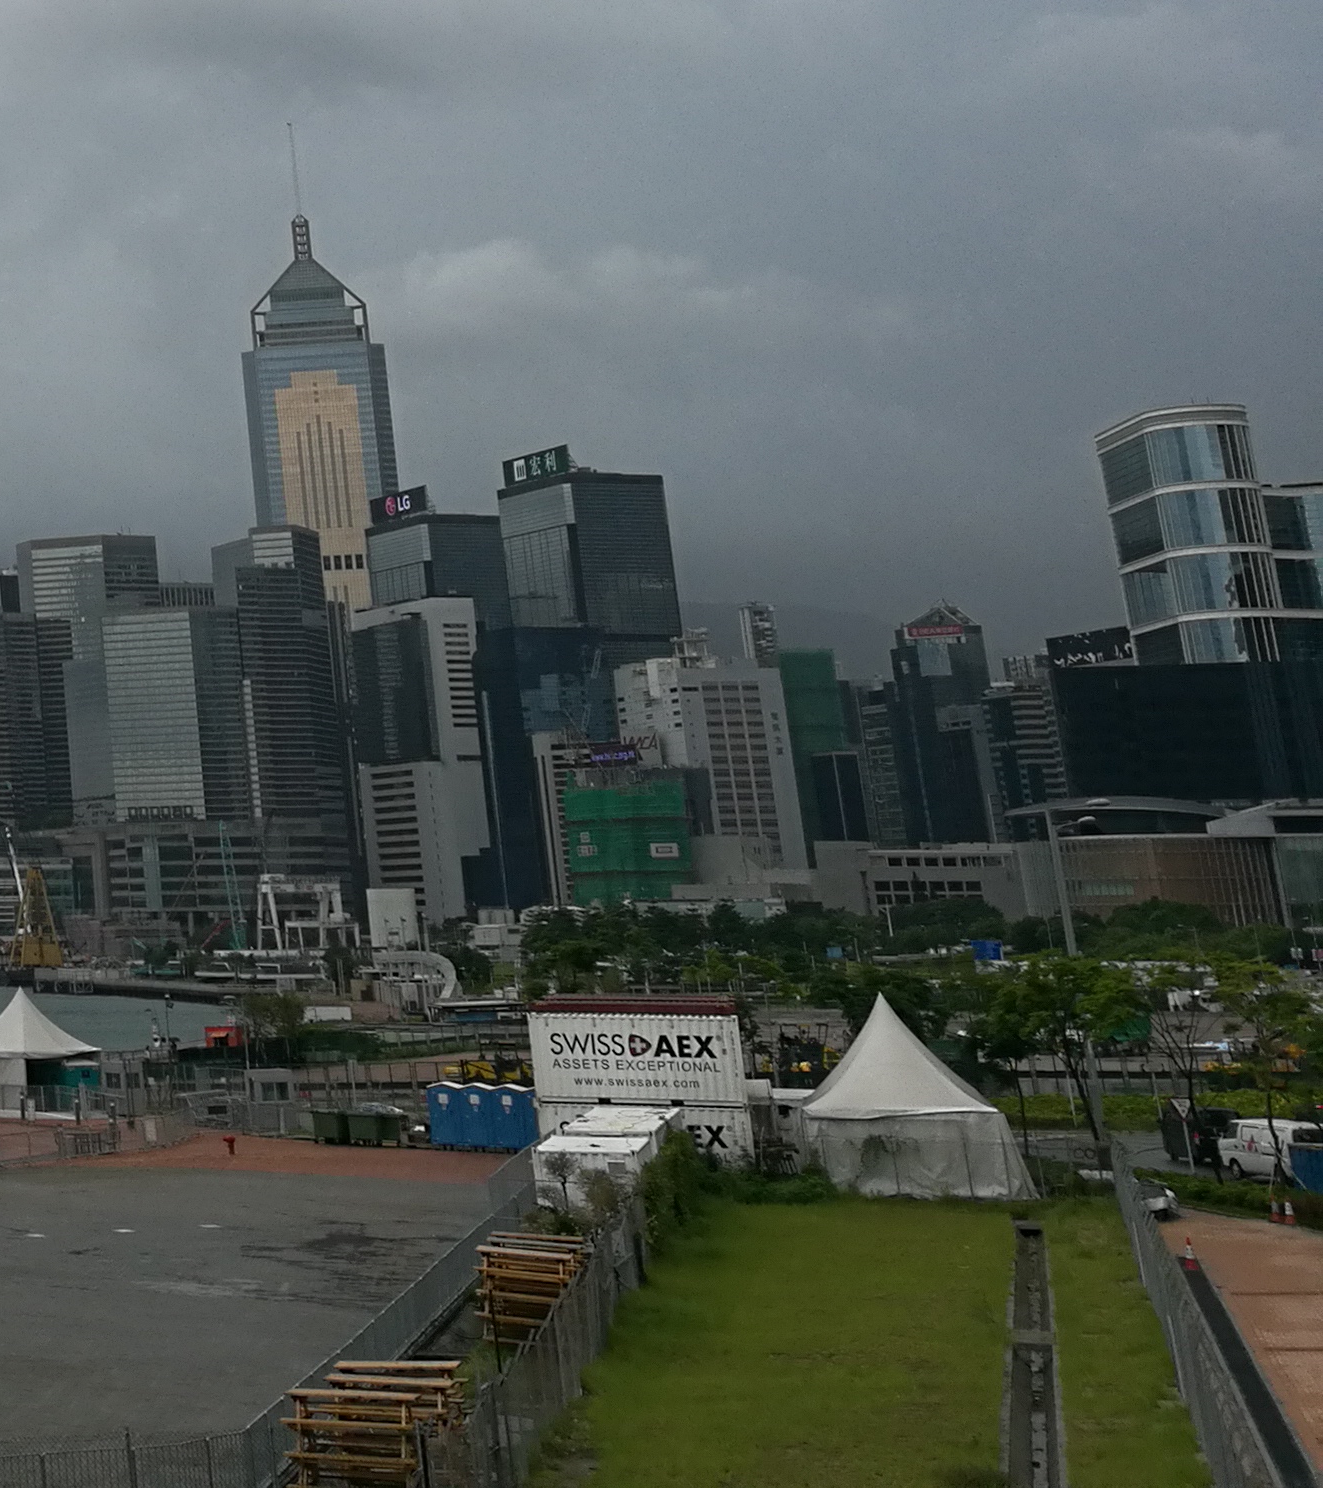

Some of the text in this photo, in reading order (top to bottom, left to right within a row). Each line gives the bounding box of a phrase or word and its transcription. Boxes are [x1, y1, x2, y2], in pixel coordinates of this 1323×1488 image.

[529, 449, 557, 476] 宏利
[396, 494, 412, 512] LG
[550, 1033, 625, 1056] SWISS
[654, 1035, 718, 1059] AEX
[552, 1058, 721, 1073] ASSETS EXCEPTIONAL
[574, 1077, 700, 1089] www.swissaex.com
